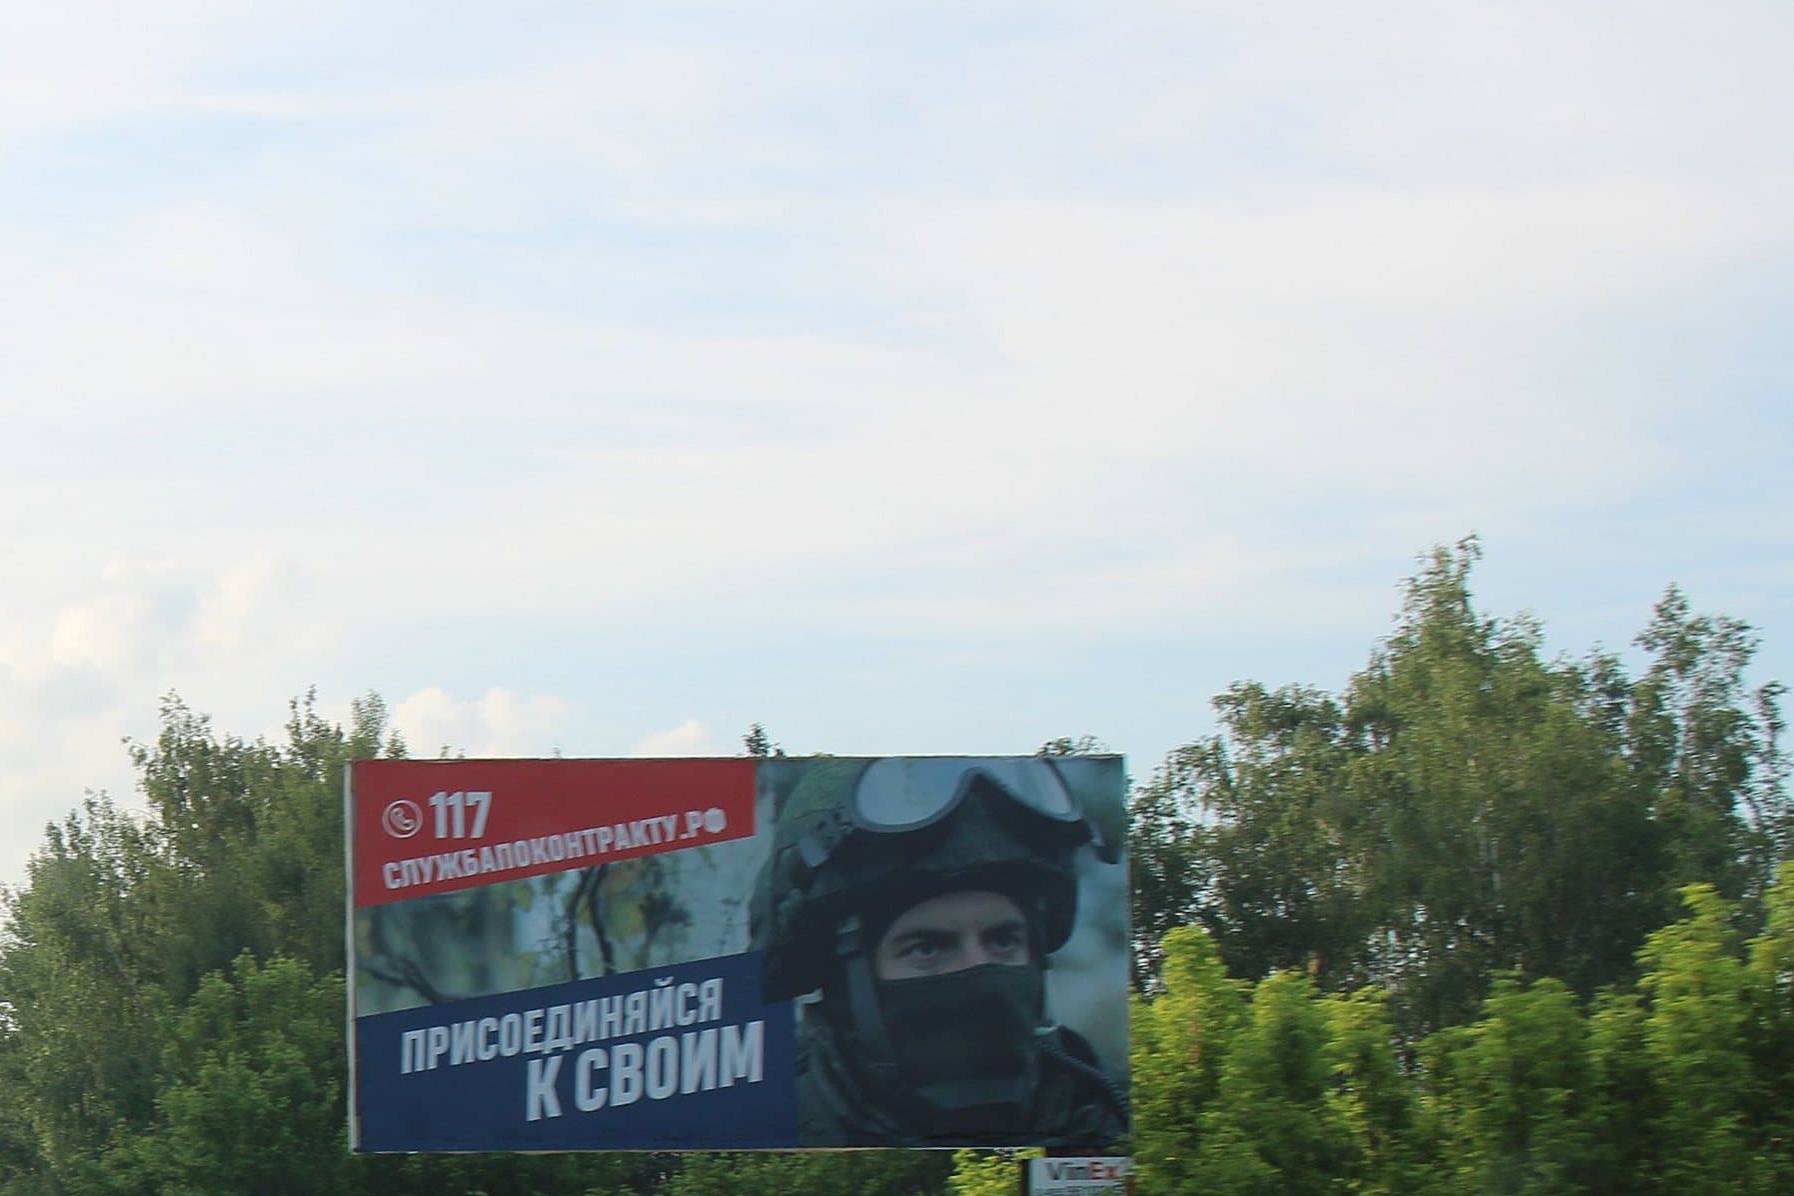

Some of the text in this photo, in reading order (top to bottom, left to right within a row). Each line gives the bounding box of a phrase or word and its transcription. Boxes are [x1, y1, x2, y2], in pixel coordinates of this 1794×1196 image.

[381, 806, 728, 890] СЛУЖБАПОКОНТРАКТУ.РФ
[429, 790, 493, 839] 117
[400, 976, 724, 1074] ПРИСОЕДИНЯЙСЯ
[525, 1019, 766, 1122] К СВОИМ
